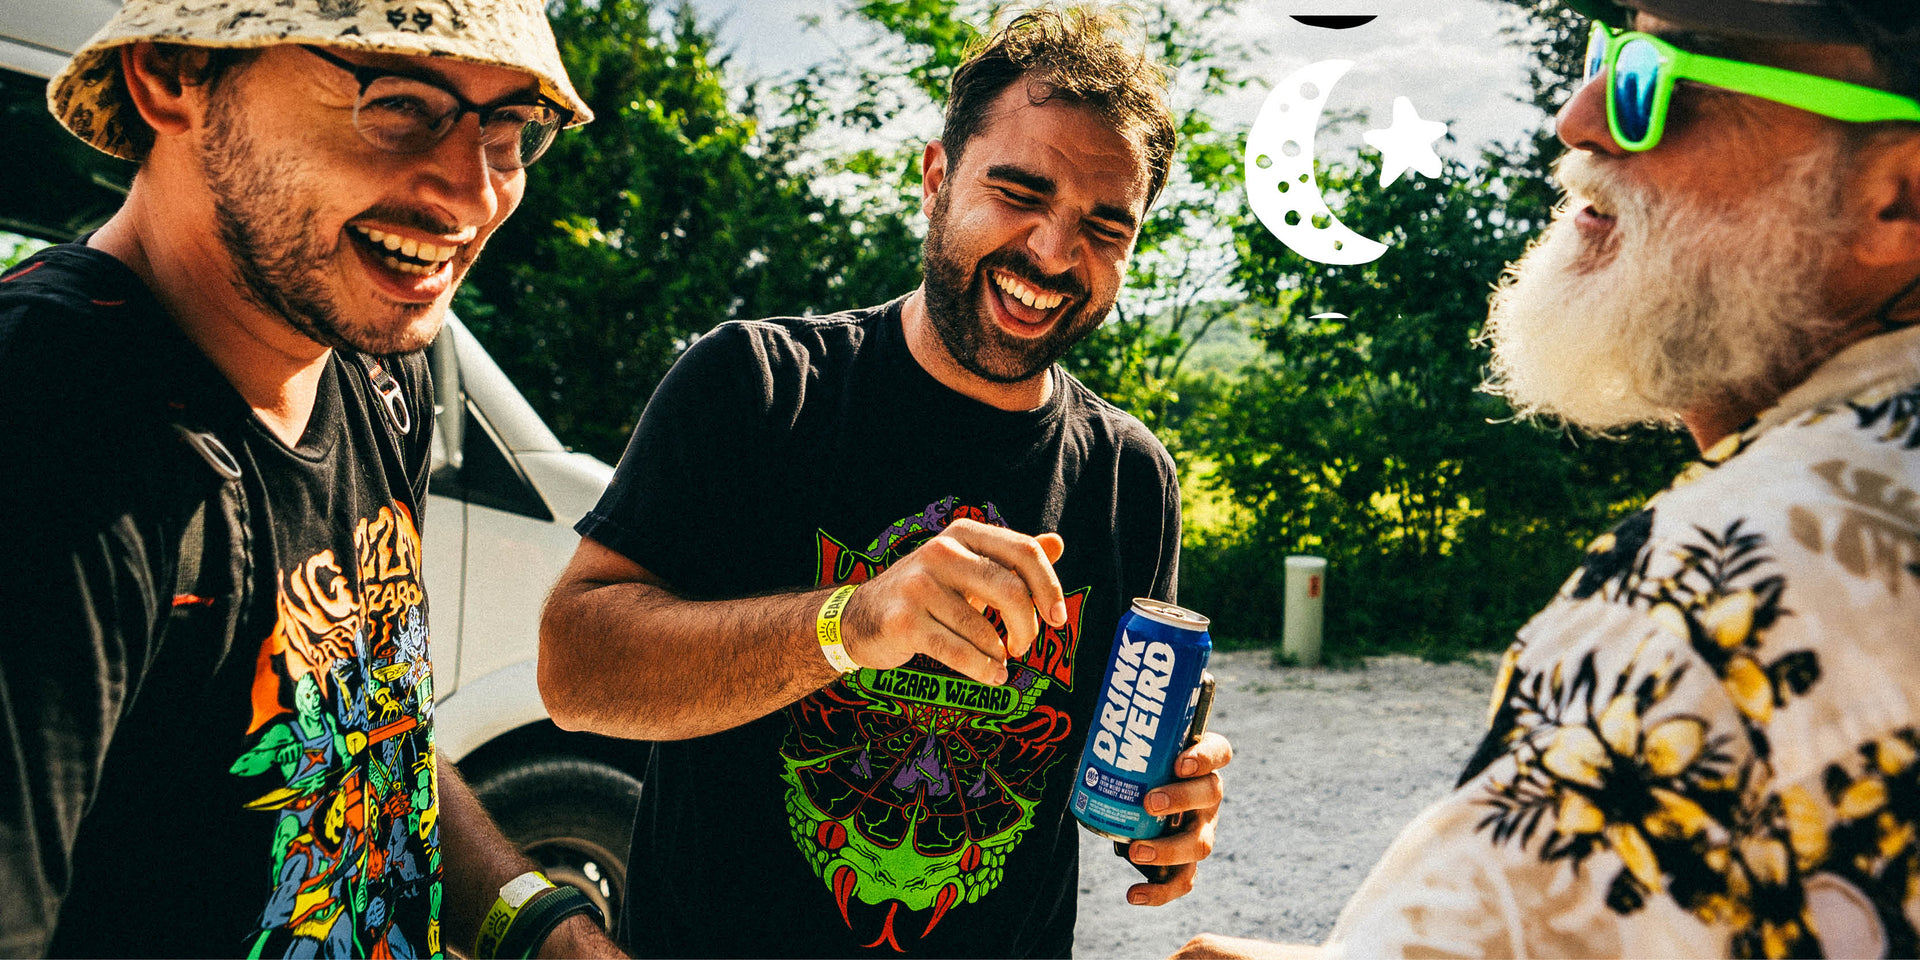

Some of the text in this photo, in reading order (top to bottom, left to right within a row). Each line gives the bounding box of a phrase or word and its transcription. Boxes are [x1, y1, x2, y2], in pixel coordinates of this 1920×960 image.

[364, 580, 423, 613] ZARD
[914, 654, 944, 669] AND
[1093, 629, 1146, 766] DRINK
[1115, 641, 1175, 773] WEIRD
